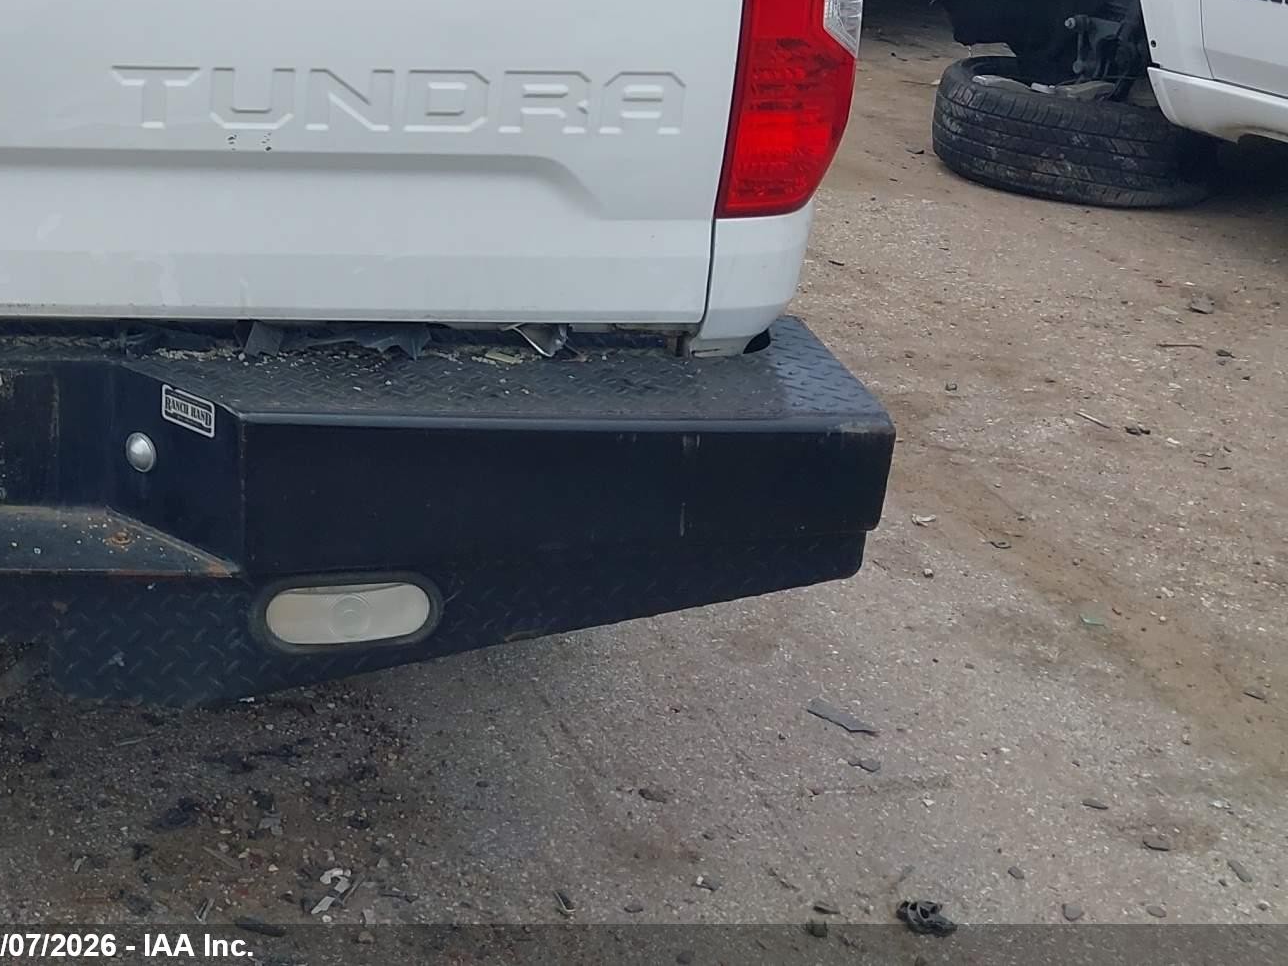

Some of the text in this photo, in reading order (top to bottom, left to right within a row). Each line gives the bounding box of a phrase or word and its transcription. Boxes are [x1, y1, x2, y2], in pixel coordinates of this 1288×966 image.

[111, 65, 687, 135] TUNDRA
[165, 395, 190, 415] RANCH
[190, 405, 212, 427] HAND
